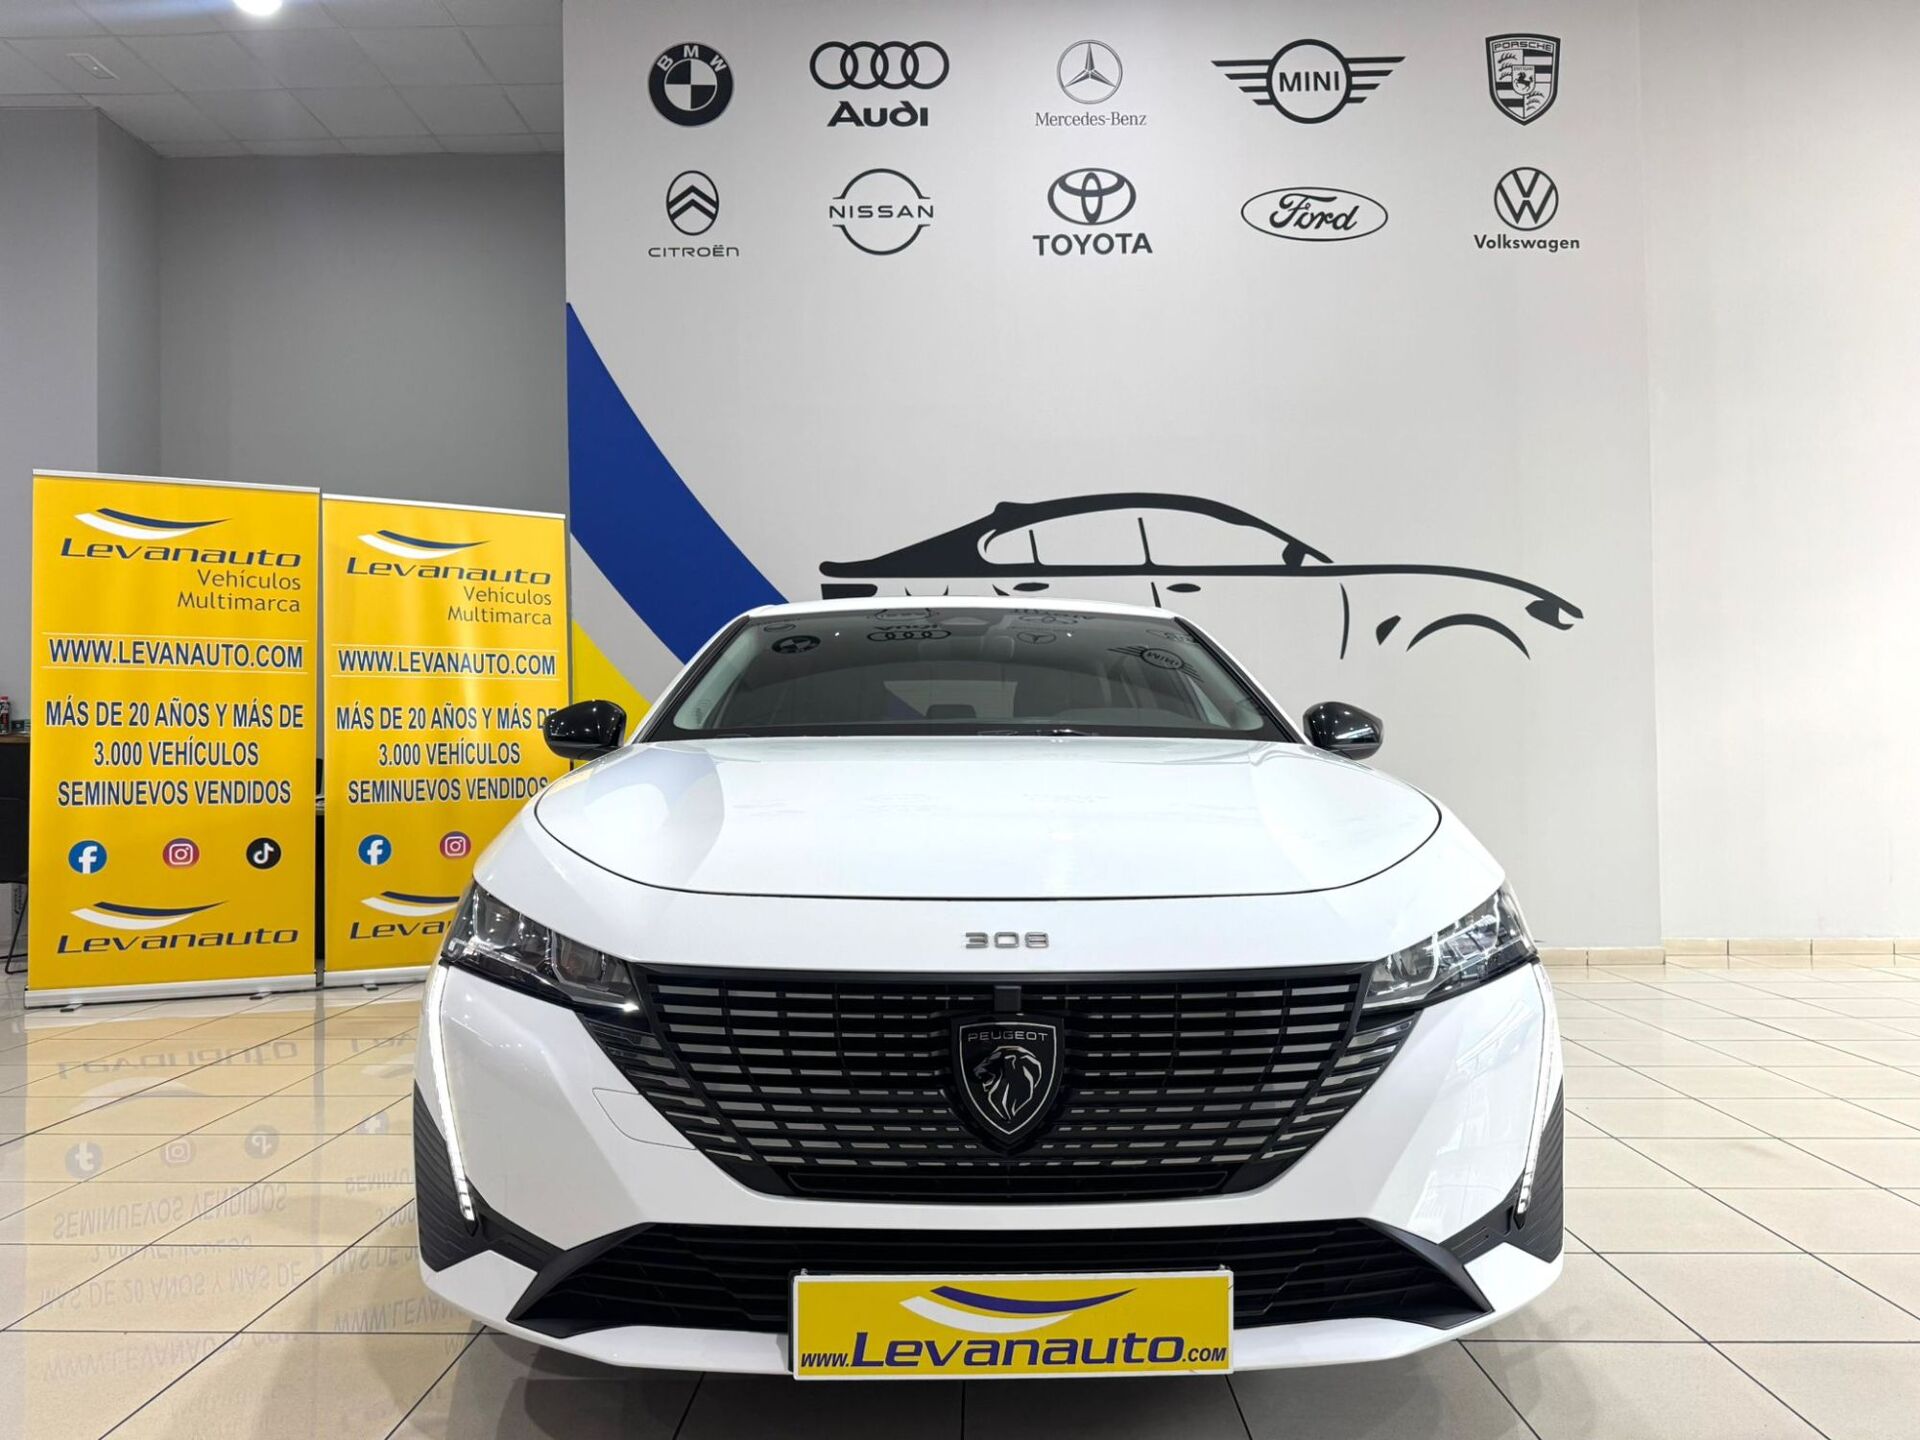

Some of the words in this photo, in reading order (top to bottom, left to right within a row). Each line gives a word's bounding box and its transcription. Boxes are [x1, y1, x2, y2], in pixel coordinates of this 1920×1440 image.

[655, 45, 727, 73] BMW
[1494, 41, 1552, 51] PORSCHE
[1278, 71, 1341, 92] MINI
[827, 101, 929, 127] Audi
[1035, 112, 1147, 126] Mercedes-Benz
[829, 205, 934, 219] NISSAN
[1269, 193, 1360, 231] Ford
[1032, 233, 1153, 256] TOYOTA
[1474, 235, 1580, 253] Volkswagen
[60, 537, 302, 568] Levanauto
[197, 569, 301, 591] Vehículos
[346, 556, 551, 585] Levanauto
[176, 591, 301, 613] Multimarca
[463, 586, 552, 606] Vehículos
[447, 605, 552, 626] Multimarca
[49, 638, 303, 668] WWW.LEVANAUTO.COM
[338, 649, 556, 676] WWW.LEVANAUTO.COM
[46, 695, 89, 727] MÁS
[96, 701, 123, 727] DE
[128, 702, 149, 727] 20
[155, 698, 210, 728] AÑOS
[215, 703, 228, 728] Y
[233, 698, 273, 728] MÁS
[279, 704, 304, 728] DE
[336, 701, 374, 730] MÁS
[380, 707, 403, 730] DE
[408, 707, 426, 730] 20
[430, 703, 477, 730] AÑOS
[482, 707, 493, 730] Y
[497, 703, 532, 730] MÁS
[94, 740, 143, 766] 3.000
[148, 736, 259, 766] VEHÍCULOS
[379, 743, 421, 766] 3.000
[426, 737, 521, 765] VEHÍCULOS
[58, 780, 189, 806] SEMINUEVOS
[194, 780, 291, 805] VENDIDOS
[348, 778, 461, 804] SEMINUEVOS
[57, 928, 299, 954] Levanauto
[965, 932, 1050, 949] 308
[967, 1031, 1049, 1042] PEUGEOT
